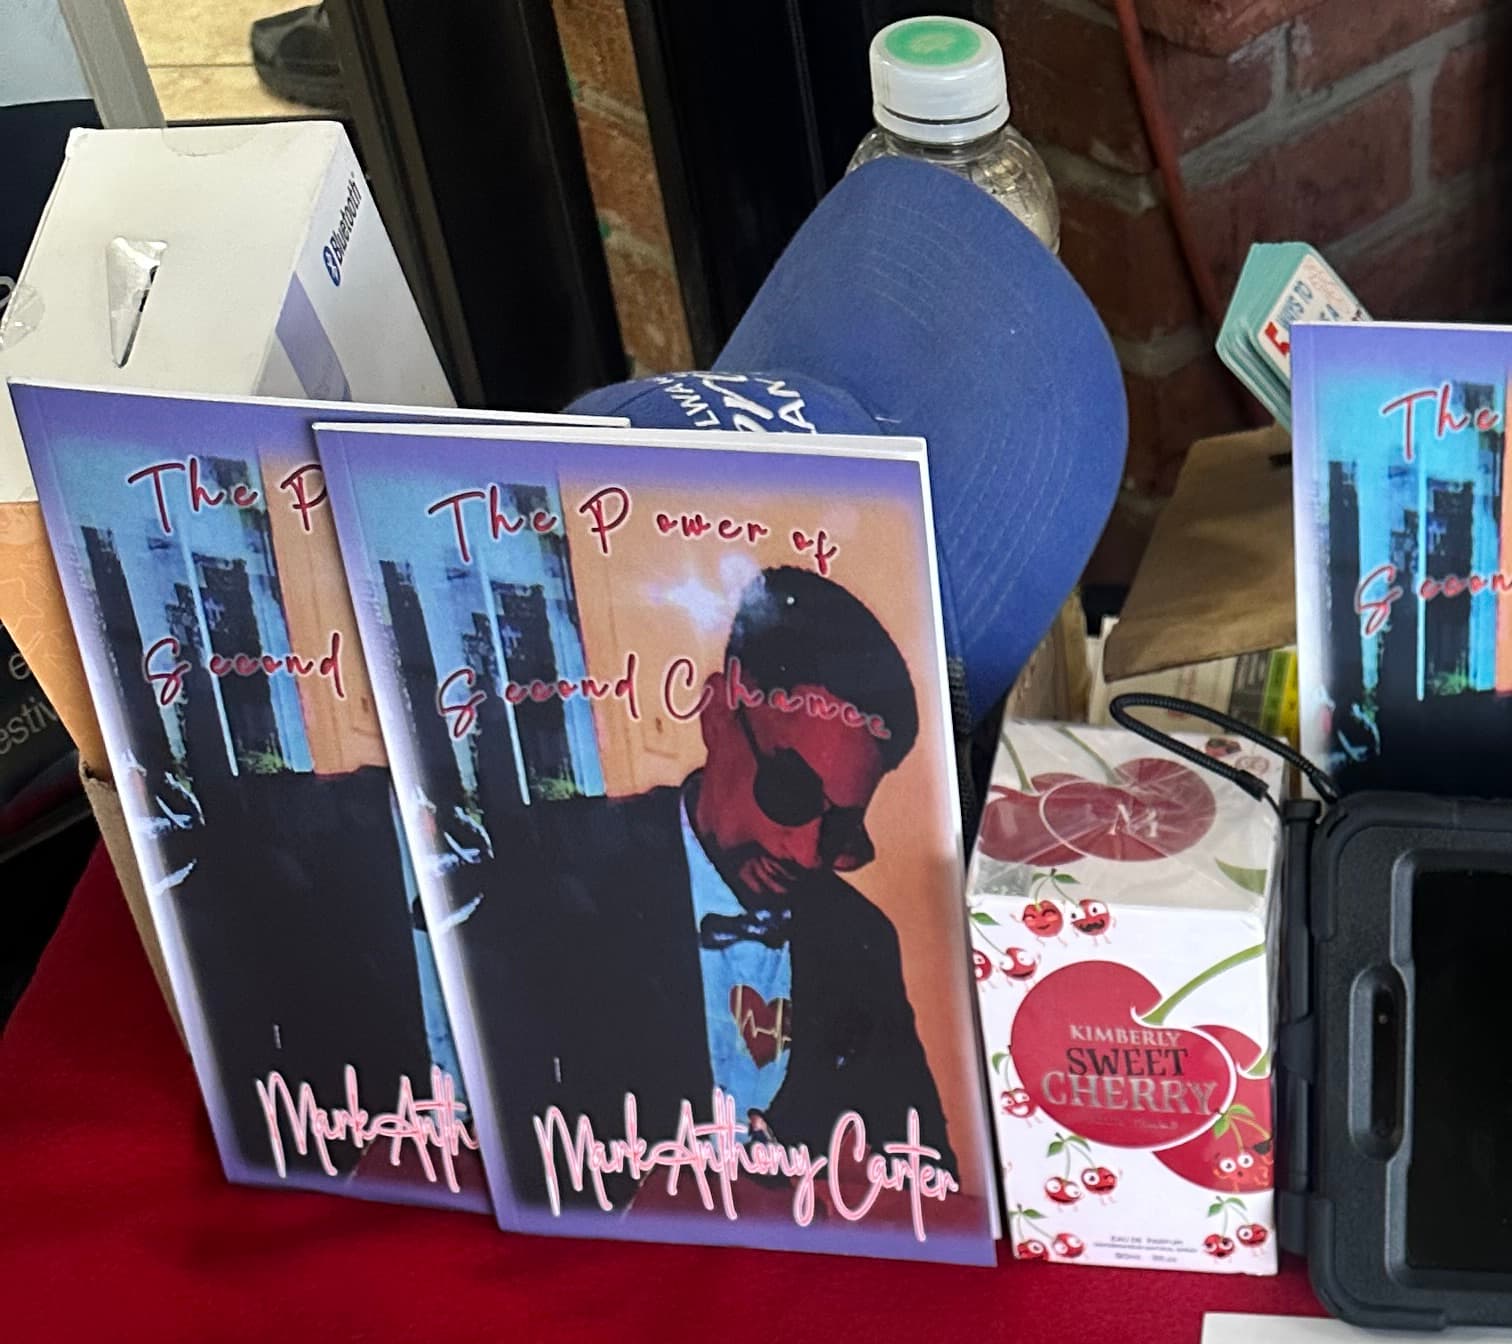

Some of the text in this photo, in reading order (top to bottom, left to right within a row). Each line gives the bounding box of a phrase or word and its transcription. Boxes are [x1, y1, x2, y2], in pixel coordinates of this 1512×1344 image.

[330, 179, 362, 266] Bluetooth
[1382, 384, 1500, 465] The
[127, 453, 262, 539] The
[429, 486, 559, 564] The
[792, 529, 840, 575] of
[1066, 1047, 1190, 1077] SWEET
[1069, 1025, 1182, 1047] KIMBERLY
[1040, 1072, 1218, 1116] CHERRY
[828, 1108, 959, 1242] Carter
